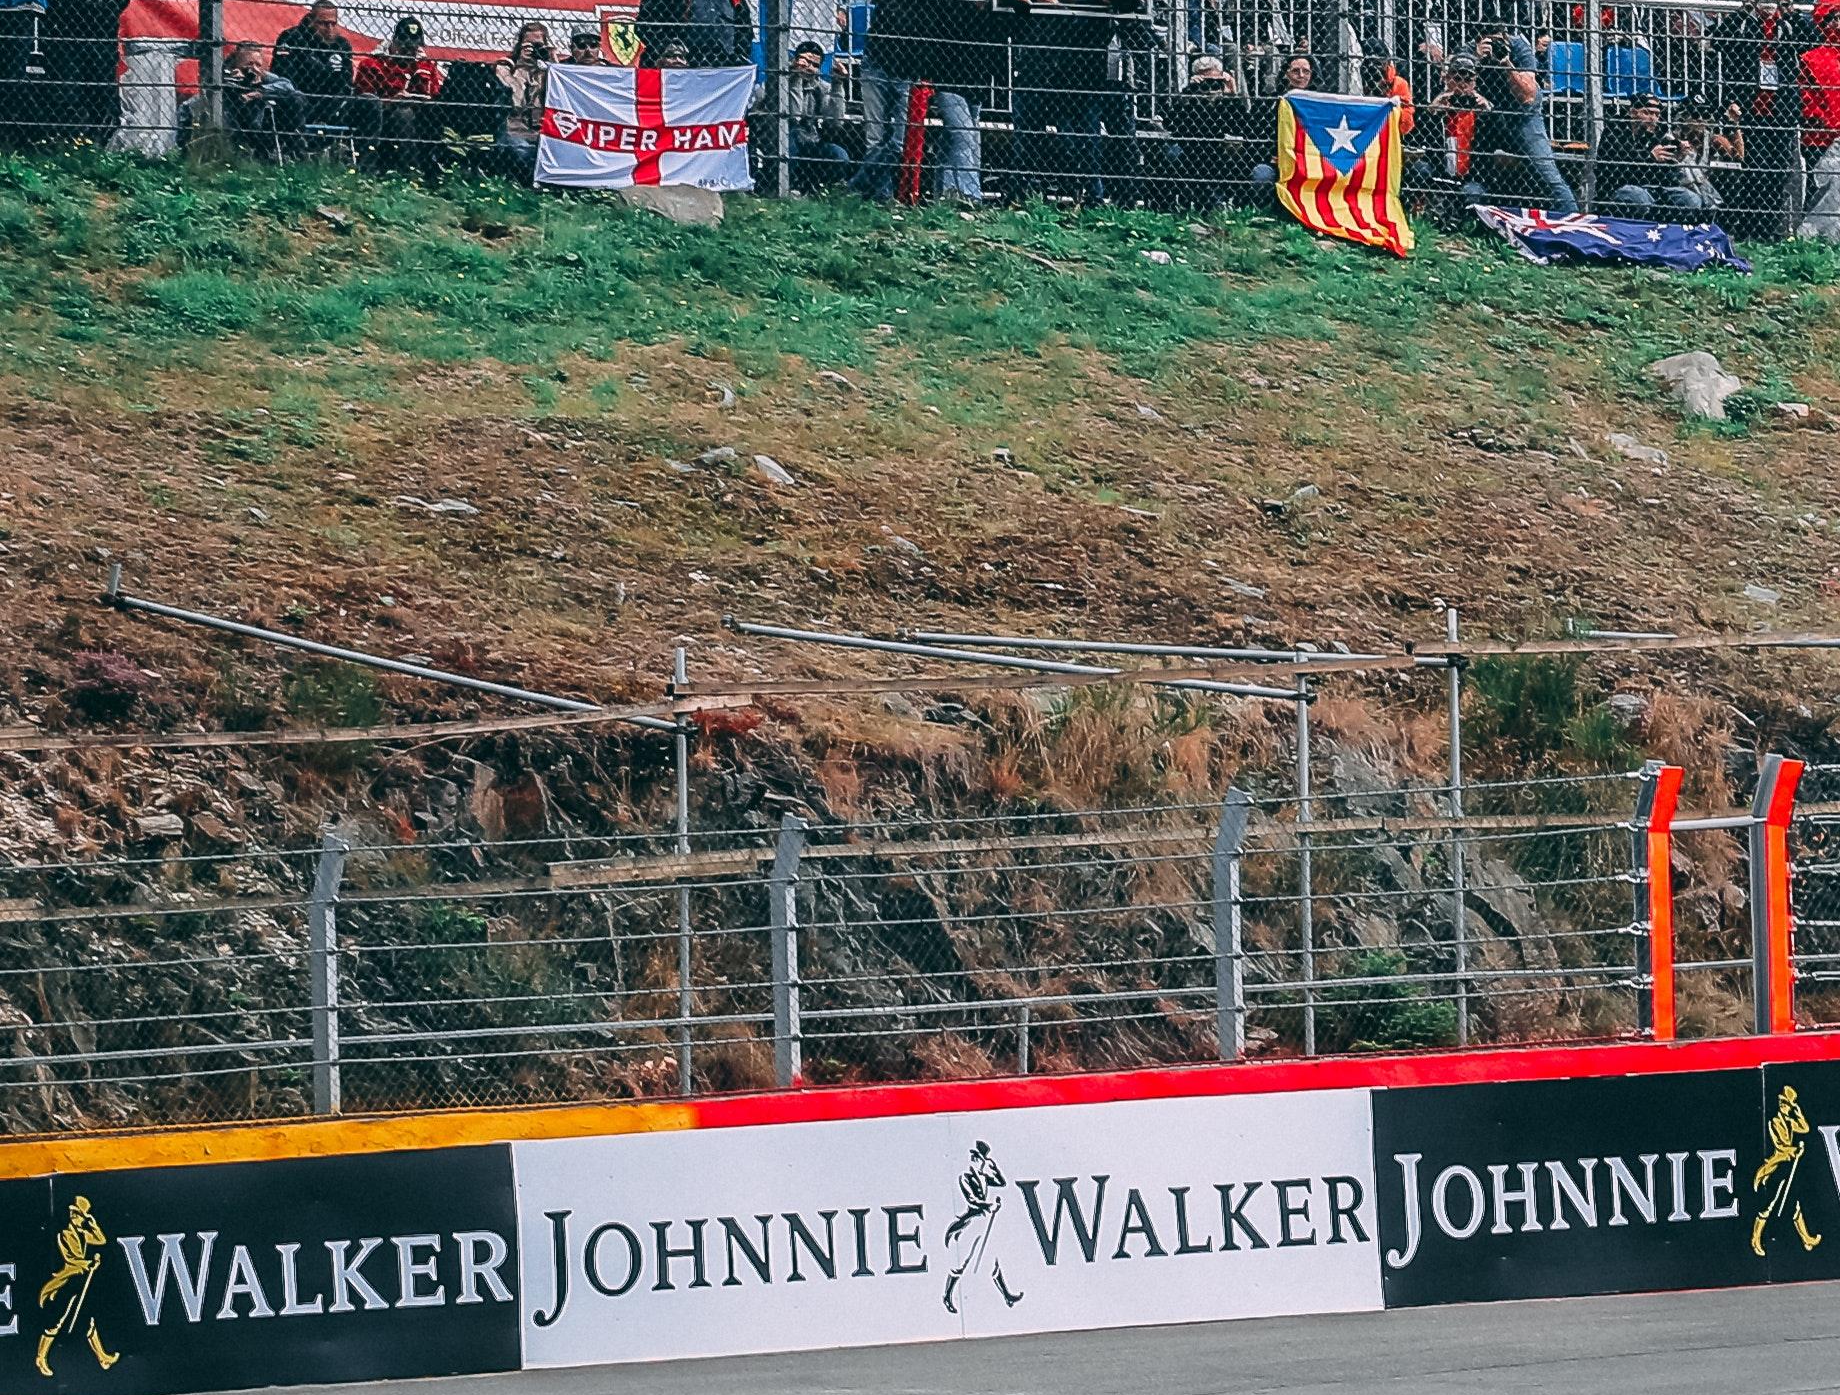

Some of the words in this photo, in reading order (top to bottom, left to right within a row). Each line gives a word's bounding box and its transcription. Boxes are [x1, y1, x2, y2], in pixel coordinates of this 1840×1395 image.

[533, 1205, 928, 1327] JOHNNIE
[1016, 1175, 1370, 1265] WALKER
[1387, 1149, 1739, 1268] JOHNNIE
[117, 1232, 513, 1325] WALKER
